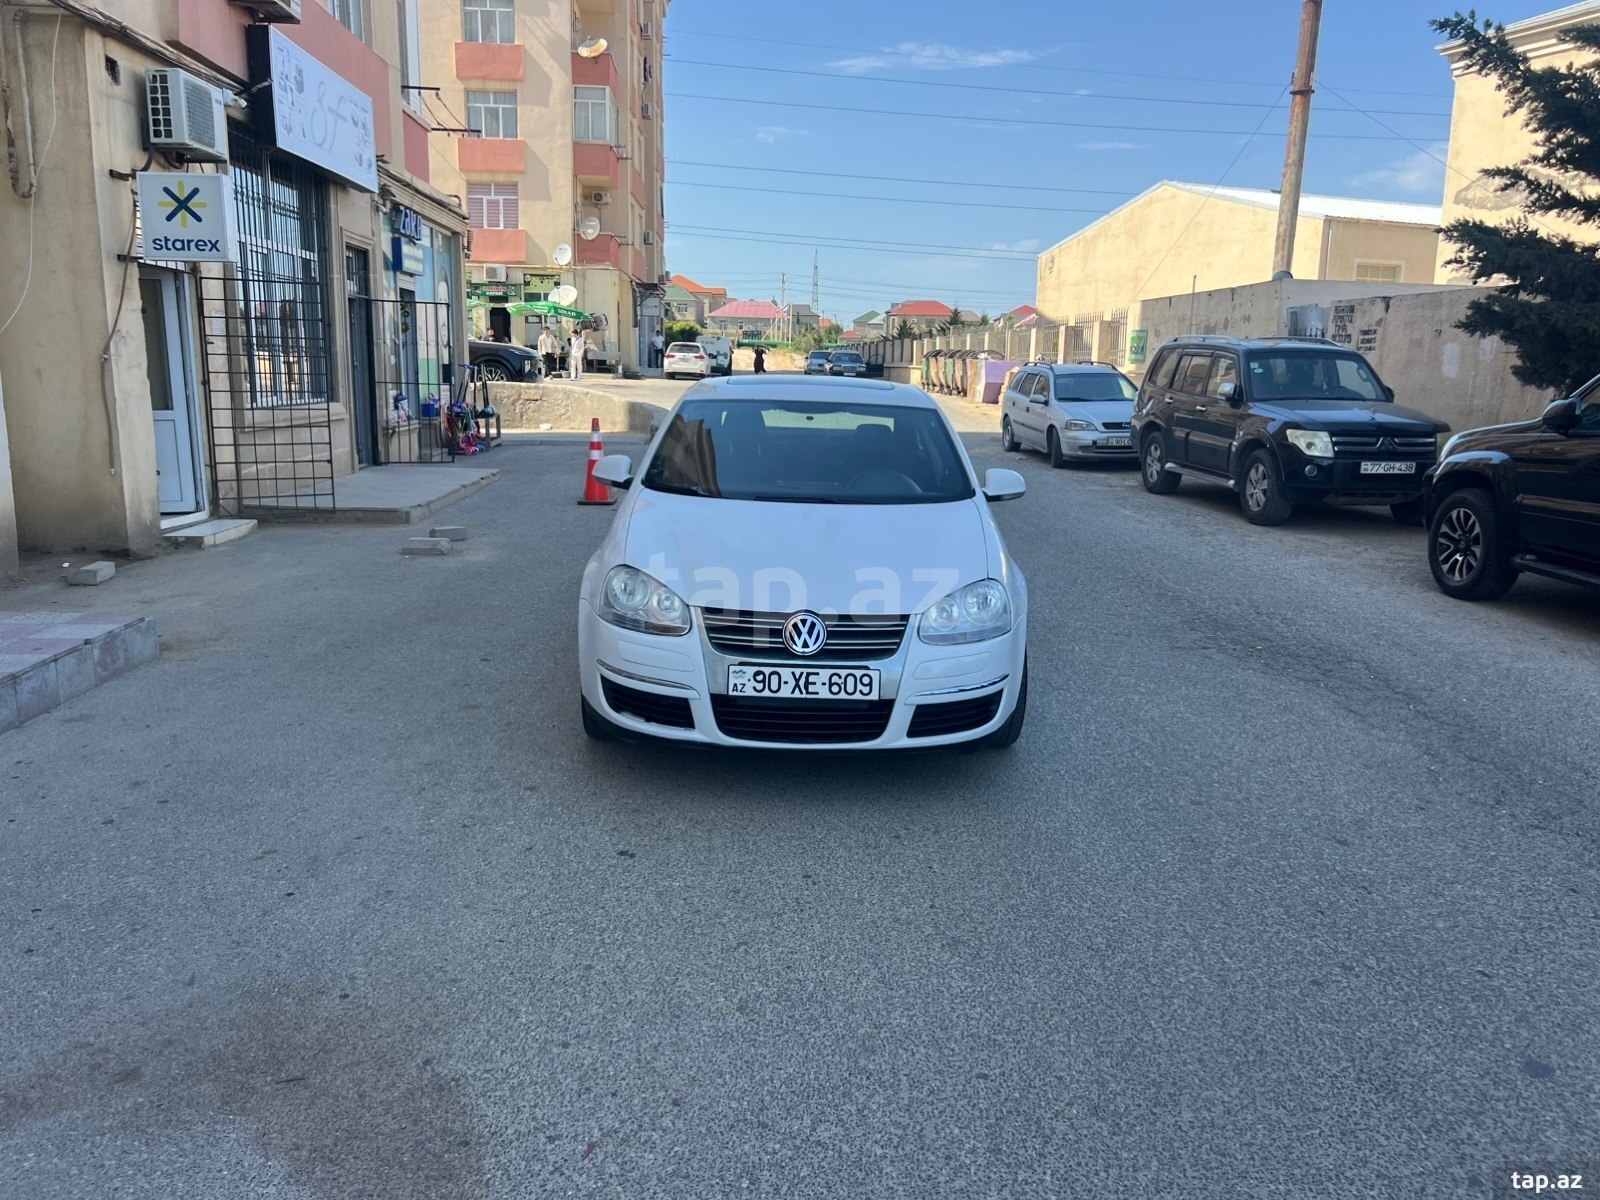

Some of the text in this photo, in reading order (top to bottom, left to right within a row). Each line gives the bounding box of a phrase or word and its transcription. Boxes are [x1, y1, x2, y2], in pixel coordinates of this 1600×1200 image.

[152, 235, 221, 252] starex
[1370, 463, 1414, 473] 77-GH-438
[731, 669, 874, 697] AZ 90-XE-609
